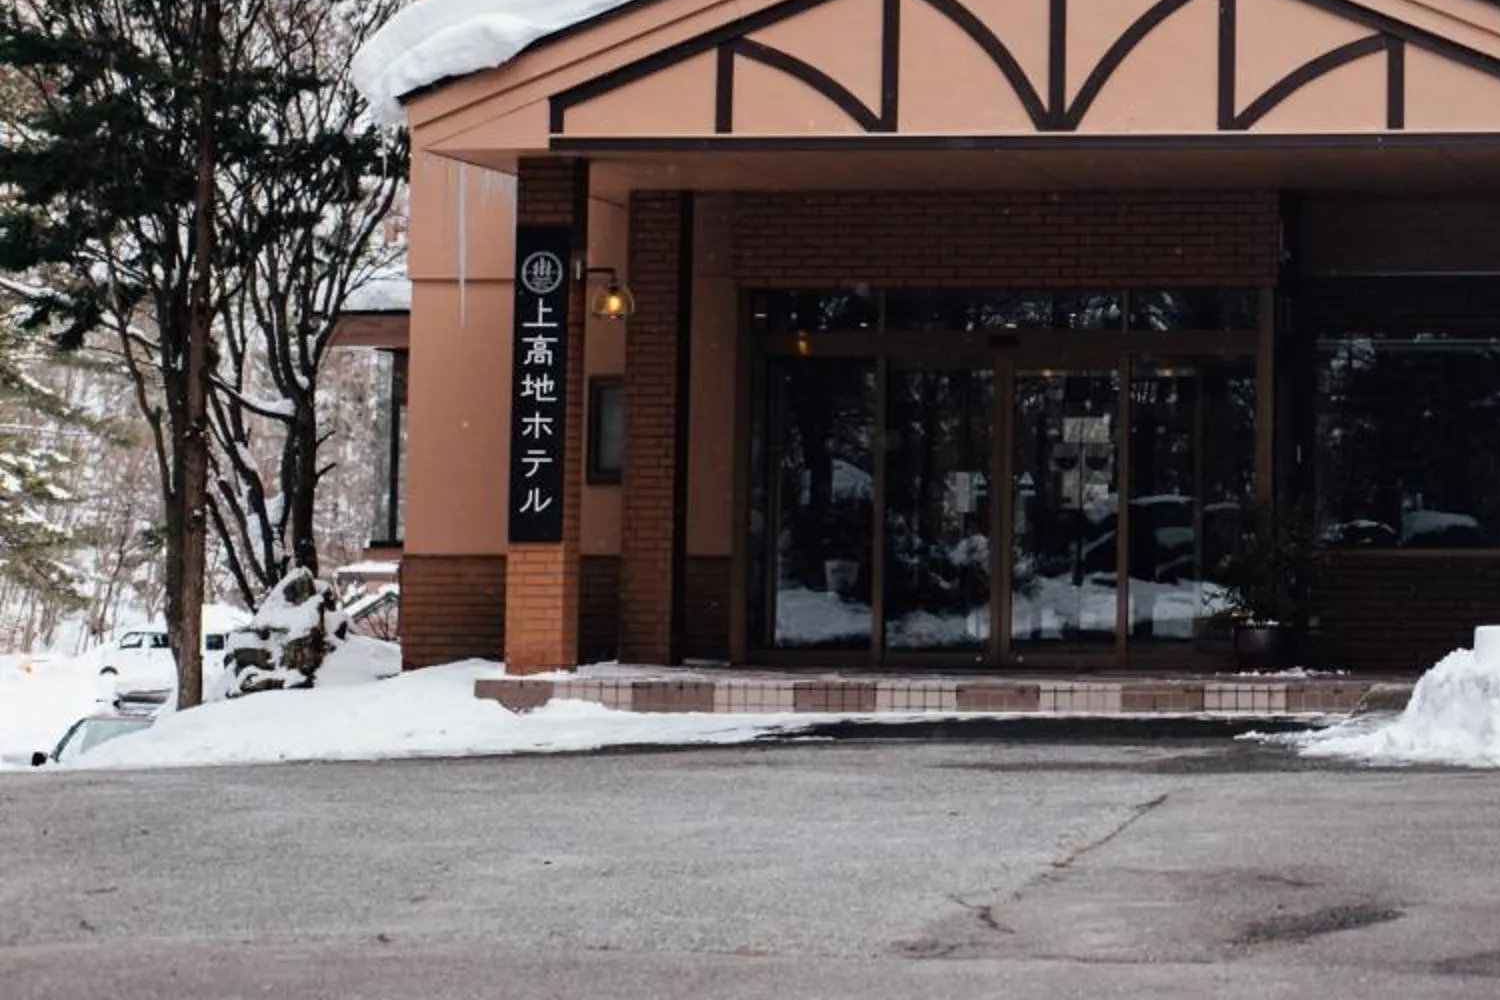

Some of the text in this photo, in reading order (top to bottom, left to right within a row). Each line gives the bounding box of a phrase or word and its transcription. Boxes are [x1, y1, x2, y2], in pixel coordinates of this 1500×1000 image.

[519, 297, 558, 513] 上高地ホテル
